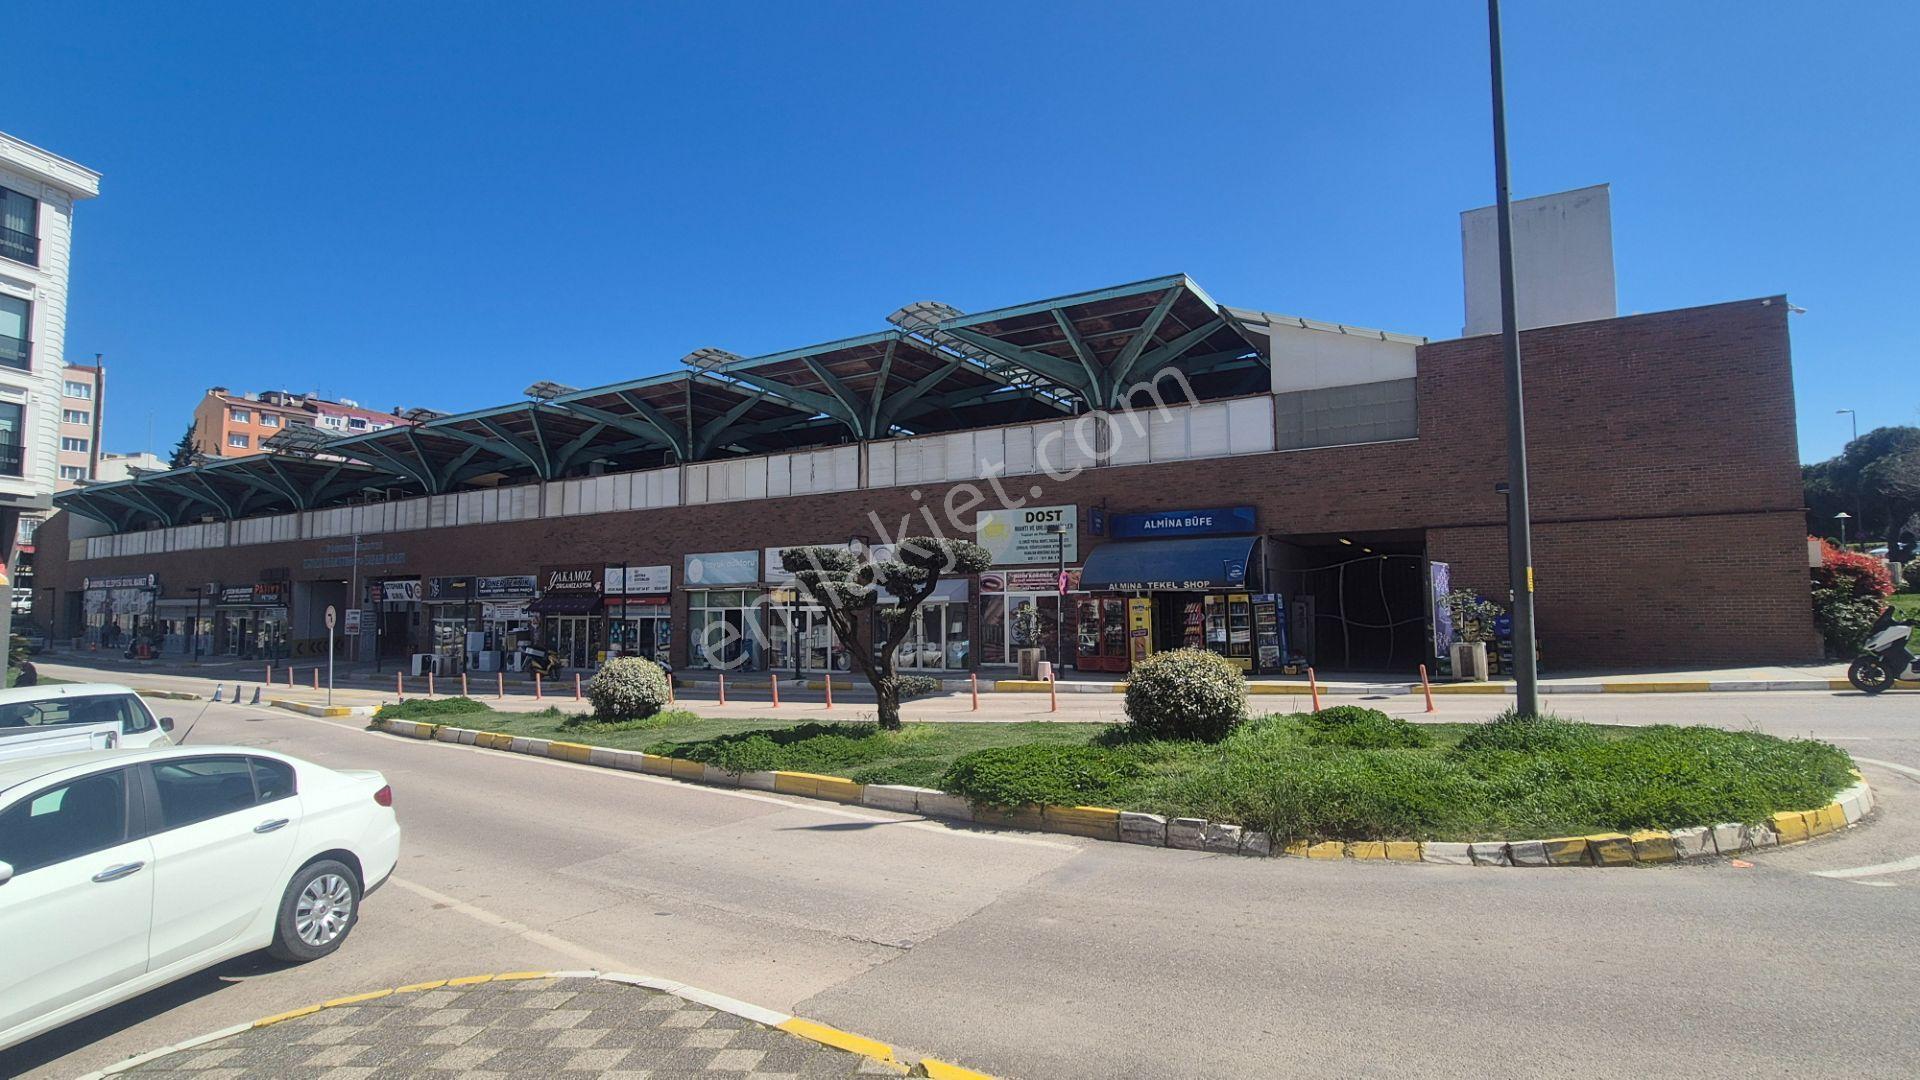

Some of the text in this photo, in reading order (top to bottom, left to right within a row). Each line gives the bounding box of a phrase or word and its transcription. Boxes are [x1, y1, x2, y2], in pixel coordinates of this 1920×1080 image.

[1025, 509, 1063, 523] DOST
[1144, 517, 1183, 529] ALMİNA
[548, 570, 593, 591] YAKAMOZ
[1147, 581, 1178, 590] TEKEL
[1183, 580, 1211, 589] SHOP
